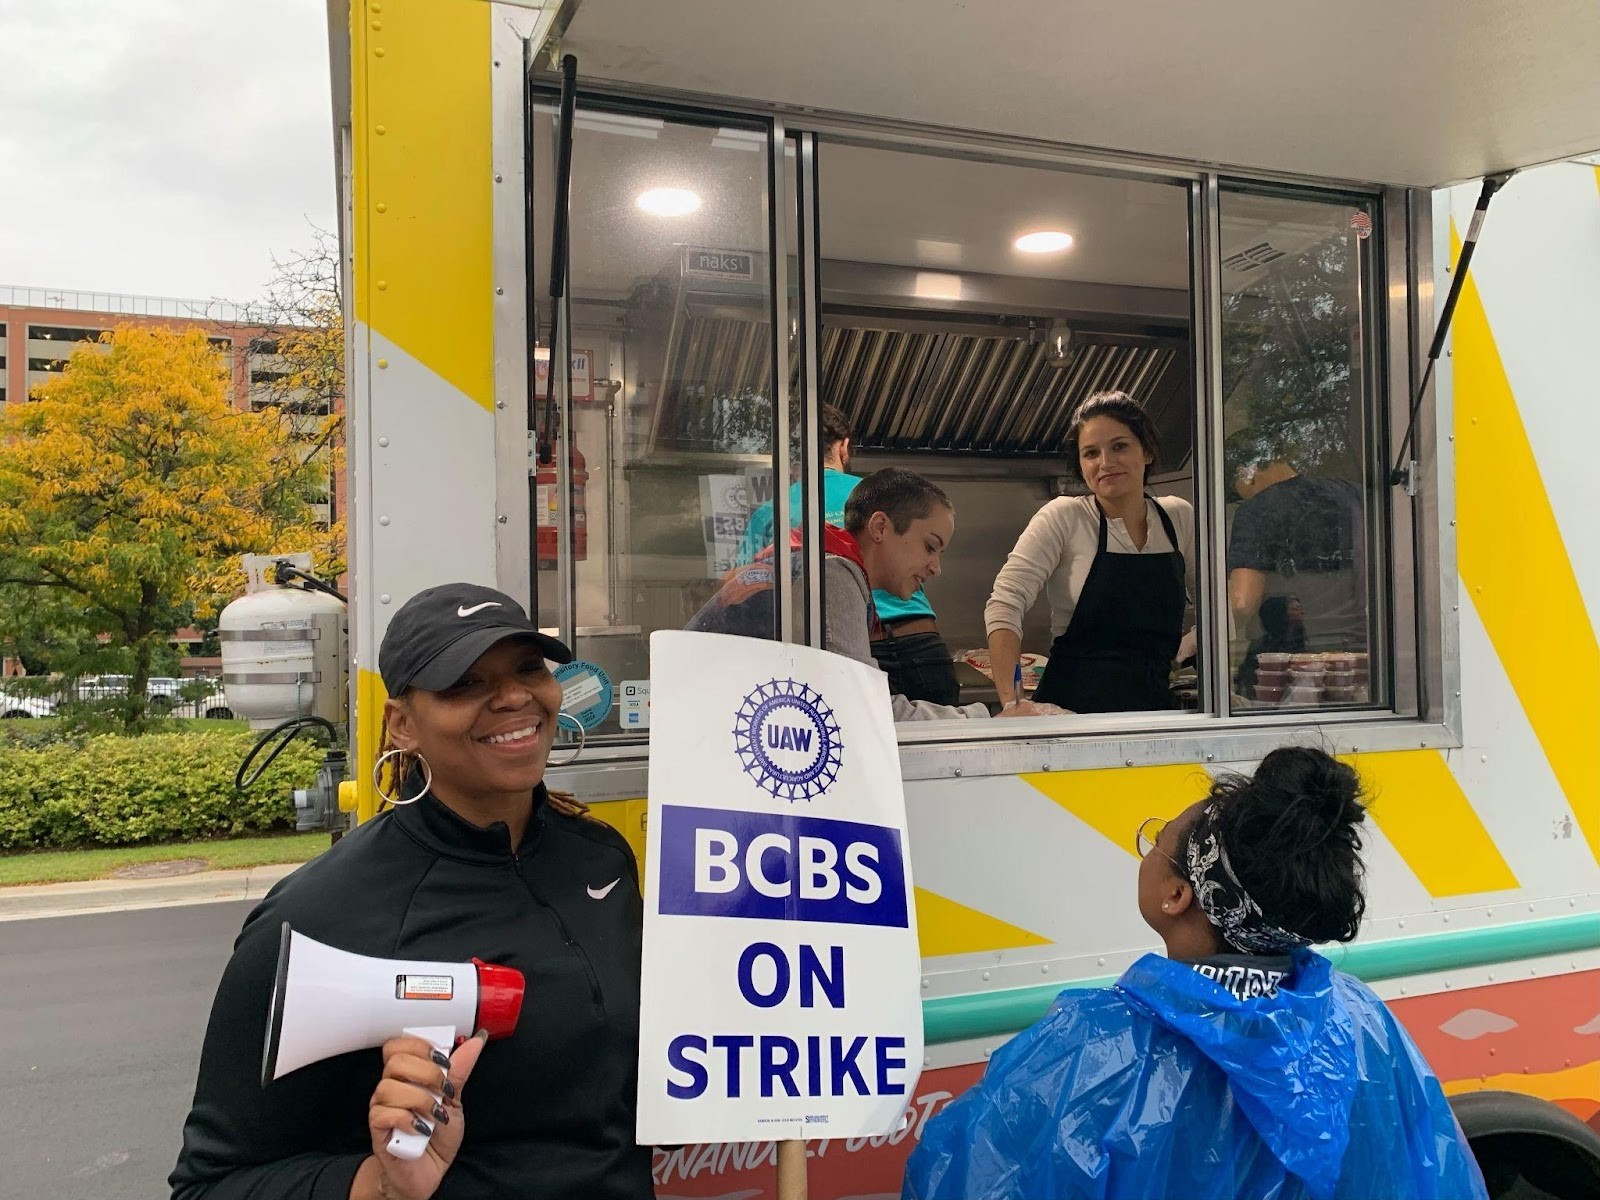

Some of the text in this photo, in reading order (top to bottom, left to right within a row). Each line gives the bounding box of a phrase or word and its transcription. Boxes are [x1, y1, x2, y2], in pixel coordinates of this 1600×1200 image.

[581, 662, 598, 673] Food
[599, 671, 609, 685] Unit
[791, 698, 810, 710] UNITED
[768, 724, 812, 752] UAW
[694, 828, 882, 904] BCBS
[738, 943, 844, 1008] ON
[667, 1035, 905, 1099] STRIKE
